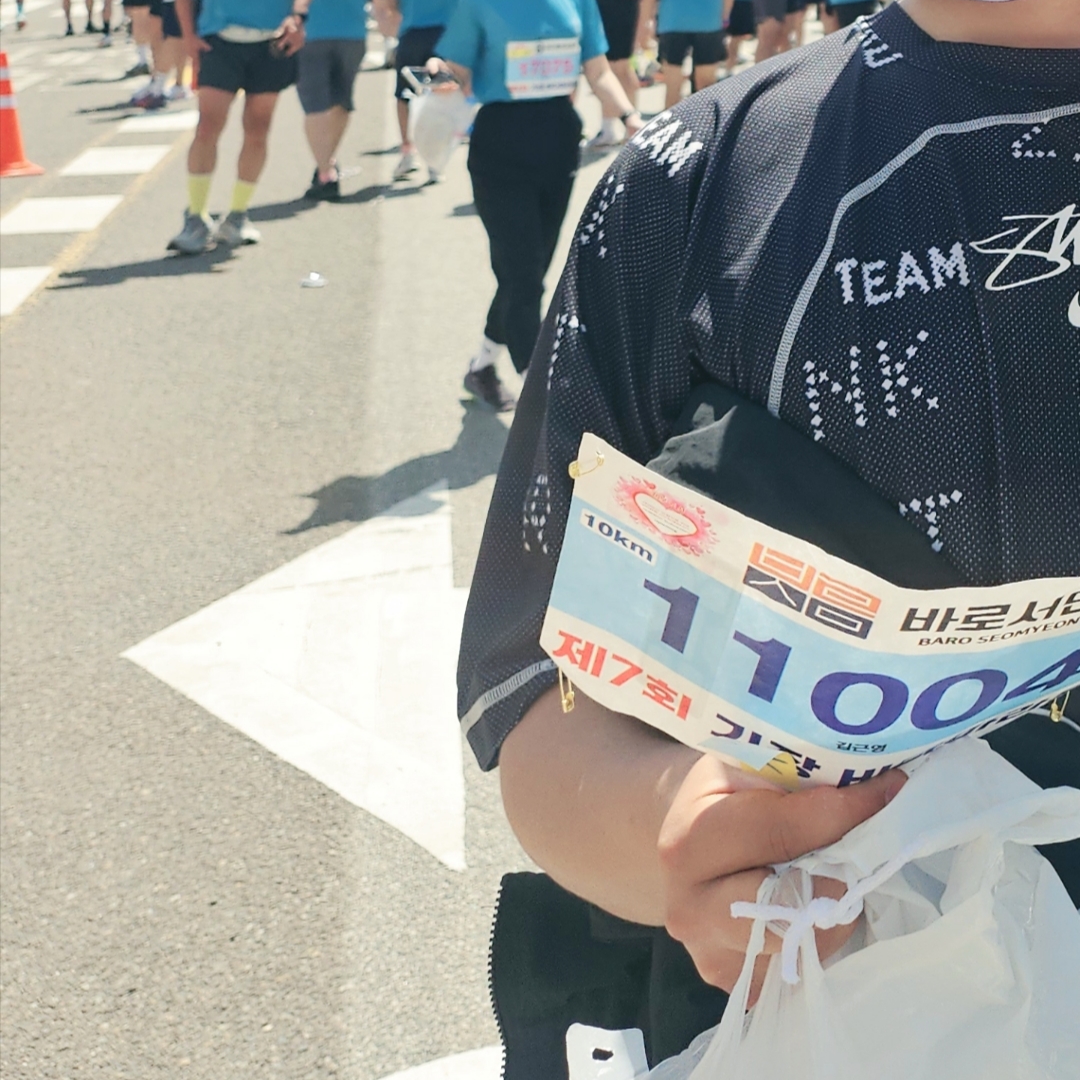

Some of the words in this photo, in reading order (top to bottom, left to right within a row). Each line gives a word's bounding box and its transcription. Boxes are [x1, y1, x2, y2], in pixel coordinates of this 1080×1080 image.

[834, 241, 970, 306] TEAM
[584, 513, 654, 563] 10km
[917, 635, 973, 647] BARO
[976, 616, 1080, 645] SEOMYEON
[551, 629, 693, 721] 제7회
[835, 740, 888, 754] 김근영
